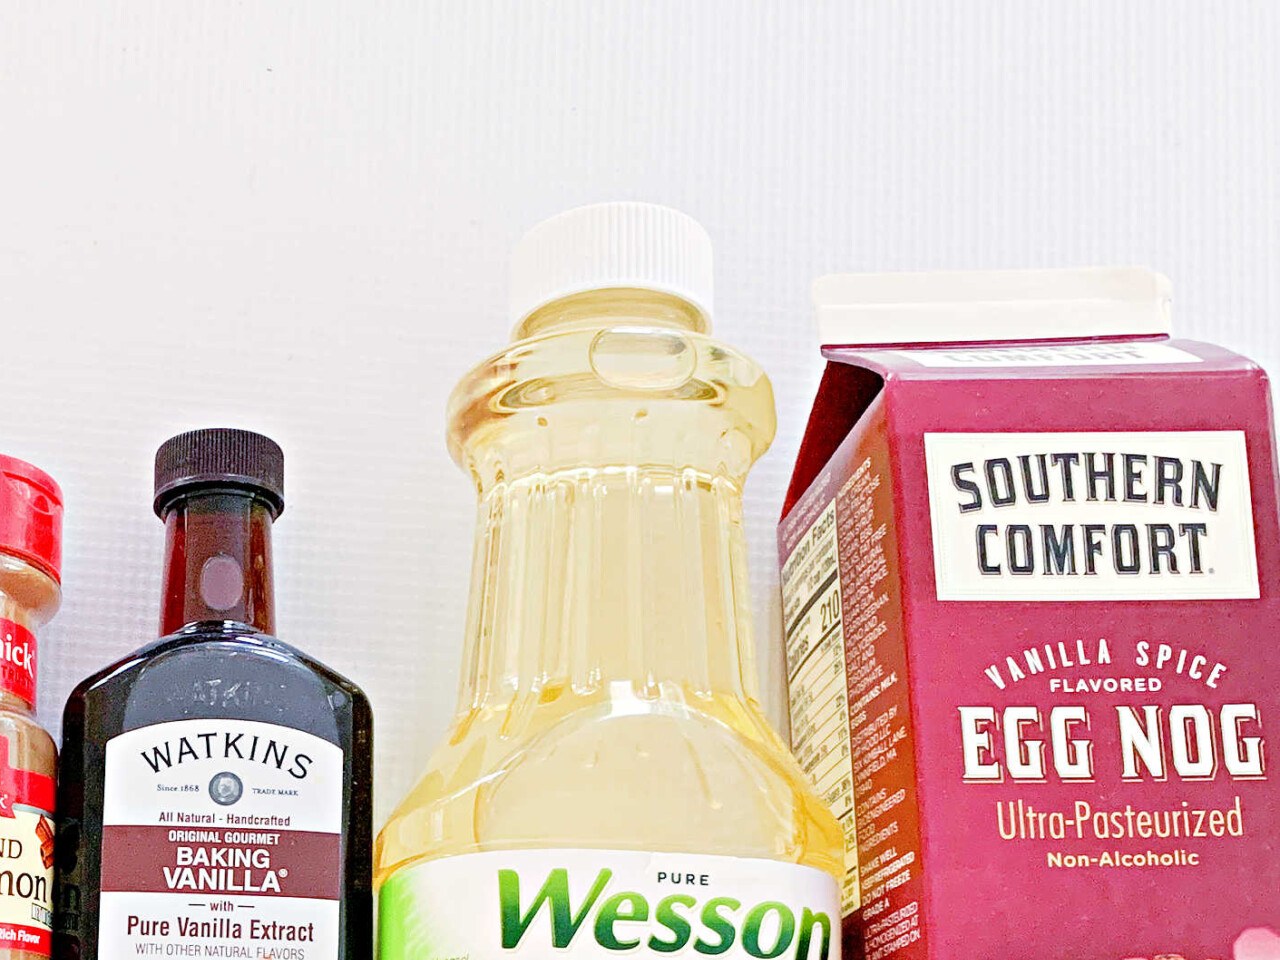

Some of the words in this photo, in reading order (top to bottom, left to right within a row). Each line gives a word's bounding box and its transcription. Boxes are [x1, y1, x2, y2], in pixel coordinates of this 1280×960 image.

[950, 451, 1224, 515] SOUTHERN
[975, 522, 1208, 577] COMFORT
[820, 589, 840, 633] 210
[984, 637, 1112, 690] VANILLA
[1135, 640, 1227, 689] SPICE
[1048, 677, 1163, 693] FLAVORED
[140, 731, 314, 780] WATKINS
[957, 704, 1096, 784] EGG
[1114, 703, 1268, 783] NOG
[156, 783, 178, 792] Since
[180, 784, 200, 793] 1868
[158, 811, 174, 823] All
[177, 811, 216, 824] Natural
[226, 813, 291, 827] Handcrafted
[996, 796, 1244, 840] Ultra-Pasteurized
[168, 829, 222, 844] ORIGINAL
[224, 831, 281, 846] GOURMET
[176, 846, 270, 869] BAKING
[1046, 849, 1200, 868] Non-Alcoholic
[162, 866, 282, 893] VANILLA
[656, 871, 710, 888] PURE
[209, 900, 235, 912] with
[127, 915, 170, 937] Pure
[177, 916, 242, 940] Vanilla
[249, 919, 314, 943] Extract
[135, 942, 163, 956] WITH
[165, 943, 202, 957] OTHER
[204, 944, 253, 959] NATURAL
[256, 945, 305, 960] FLAVORS
